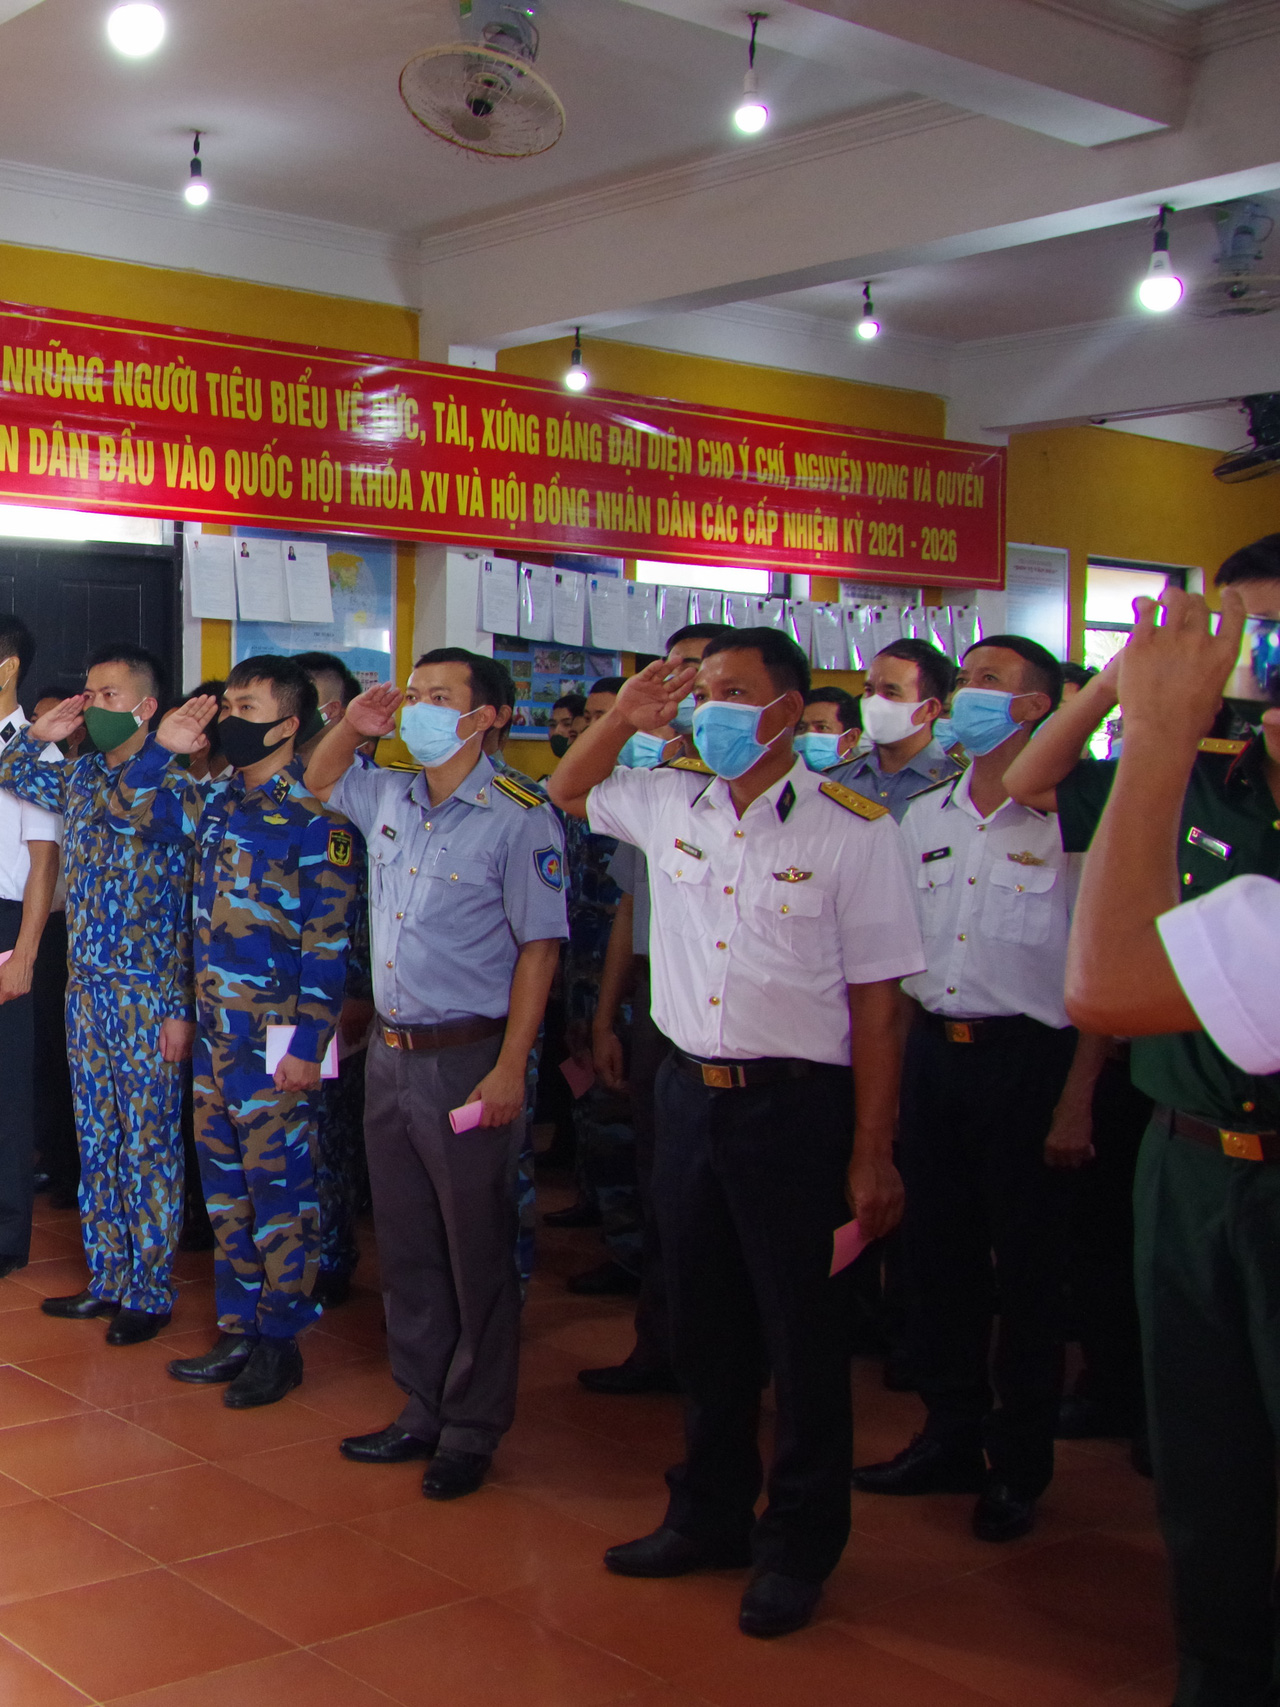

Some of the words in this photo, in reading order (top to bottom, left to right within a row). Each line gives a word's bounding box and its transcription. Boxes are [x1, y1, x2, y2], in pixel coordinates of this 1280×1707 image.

[3, 339, 105, 403] NHỮNG
[113, 355, 198, 414] NGƯỜI
[206, 365, 262, 421] TIÊU
[270, 366, 327, 430] BIỂU
[335, 376, 365, 433] VỀ
[433, 394, 474, 452] TÀI,
[481, 399, 539, 455] XỨNG
[546, 411, 602, 464] ĐÁNG
[608, 425, 641, 476] ĐẠI
[647, 426, 692, 481] DIỆN
[697, 438, 735, 479] CHO
[738, 436, 750, 482] Ý
[794, 450, 862, 501] NGUYỆN
[866, 461, 909, 505] VỌNG
[913, 460, 931, 502] VÀ
[28, 420, 90, 481] DÂN
[98, 422, 155, 486] BẦU
[162, 434, 216, 493] VÀO
[224, 437, 293, 500] QUỐC
[301, 450, 342, 513] HỘI
[350, 458, 414, 511] KHÓA
[420, 470, 449, 515] XV
[455, 467, 485, 520] VÀ
[490, 471, 527, 531] HỘI
[533, 470, 590, 527] ĐỒNG
[595, 486, 651, 535] NHÂN
[656, 492, 696, 540] DÂN
[701, 496, 738, 545] CÁC
[743, 496, 778, 546] CẤP
[783, 507, 839, 559] NHIỆM
[843, 512, 864, 554] KỲ
[868, 520, 905, 558] 2021
[921, 526, 957, 563] 2026
